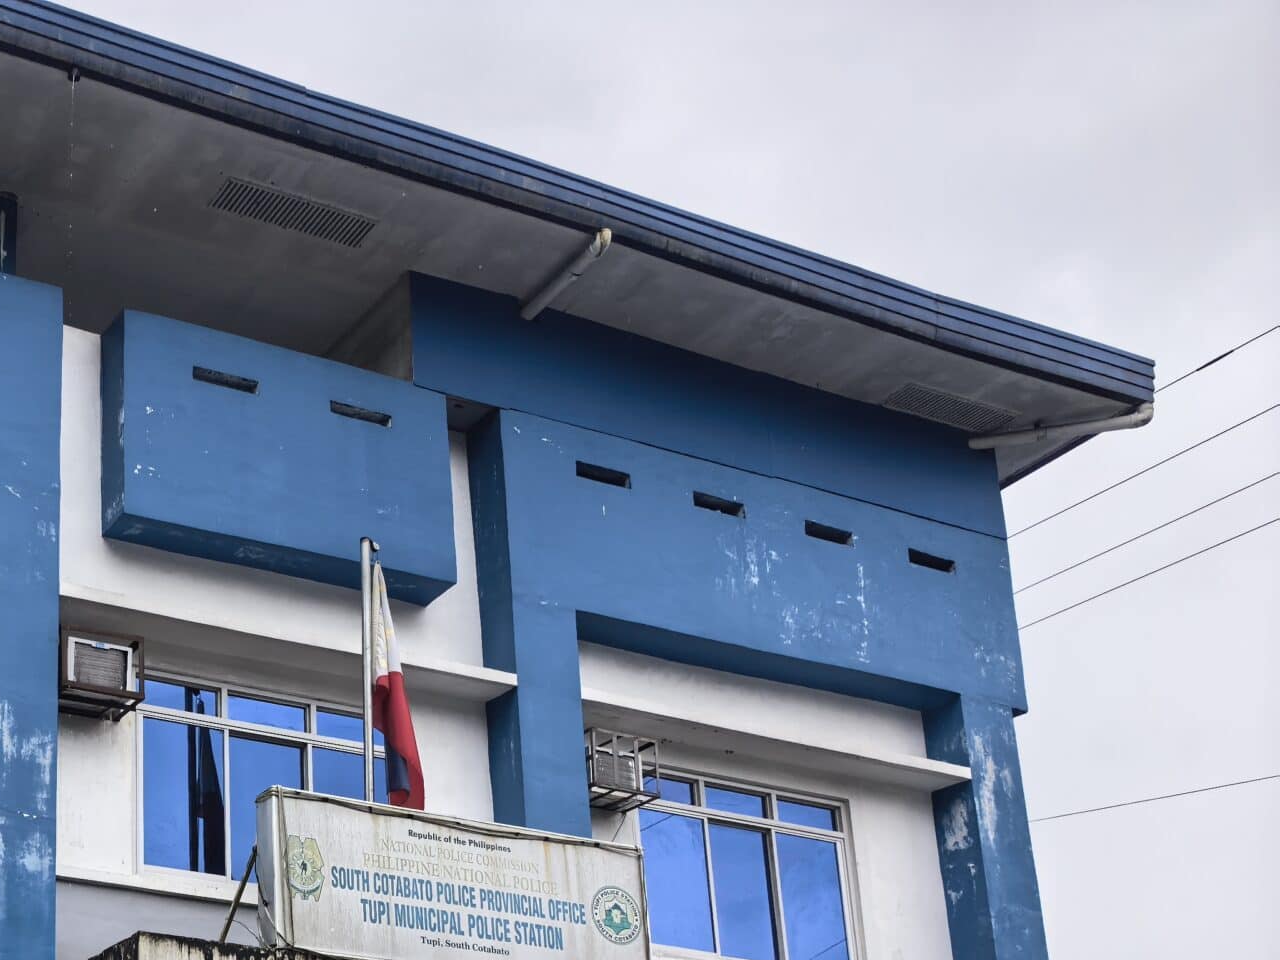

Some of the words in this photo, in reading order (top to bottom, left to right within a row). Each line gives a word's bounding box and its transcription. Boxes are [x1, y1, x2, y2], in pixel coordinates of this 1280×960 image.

[381, 839, 435, 858] NATIONAL
[438, 847, 473, 864] POLICE
[477, 853, 539, 874] COMMISSION
[408, 829, 441, 841] Republic
[454, 837, 466, 845] the
[469, 839, 511, 853] Philippines
[363, 853, 439, 877] PHILIPPINE
[442, 865, 511, 888] NATIONAL
[512, 876, 558, 896] POLICE
[331, 865, 370, 893] SOUTH
[373, 872, 433, 902] COTABATO
[436, 881, 477, 908] POLICE
[480, 888, 546, 919] PROVINCIAL
[548, 898, 587, 925] OFFICE
[360, 898, 391, 926] TUPI
[394, 903, 465, 936] MUNICIPAL
[467, 913, 512, 943] POLICE
[514, 920, 564, 951] STATION
[420, 936, 443, 948] Tupi,
[445, 940, 470, 951] South
[472, 943, 510, 956] Cotabato
